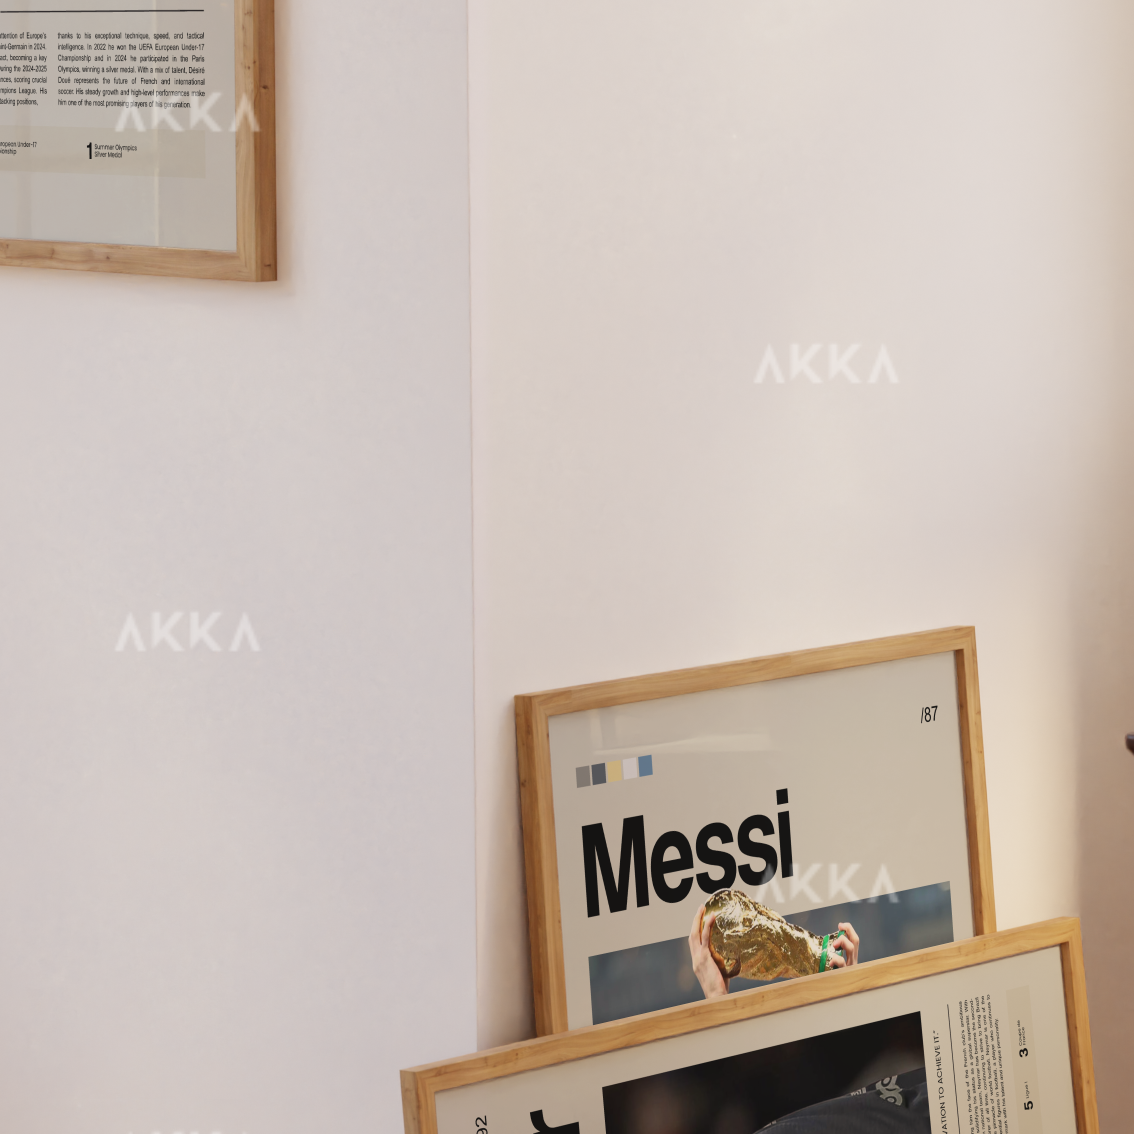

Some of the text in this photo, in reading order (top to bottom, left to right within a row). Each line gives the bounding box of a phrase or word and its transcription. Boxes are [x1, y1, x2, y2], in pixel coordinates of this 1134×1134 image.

[86, 142, 92, 159] 1
[920, 705, 938, 724] /87
[581, 787, 794, 918] Messi
[1019, 1047, 1029, 1058] 3
[934, 1045, 944, 1084] ACHIEVE
[938, 1086, 945, 1101] TO
[1023, 1100, 1034, 1110] 5
